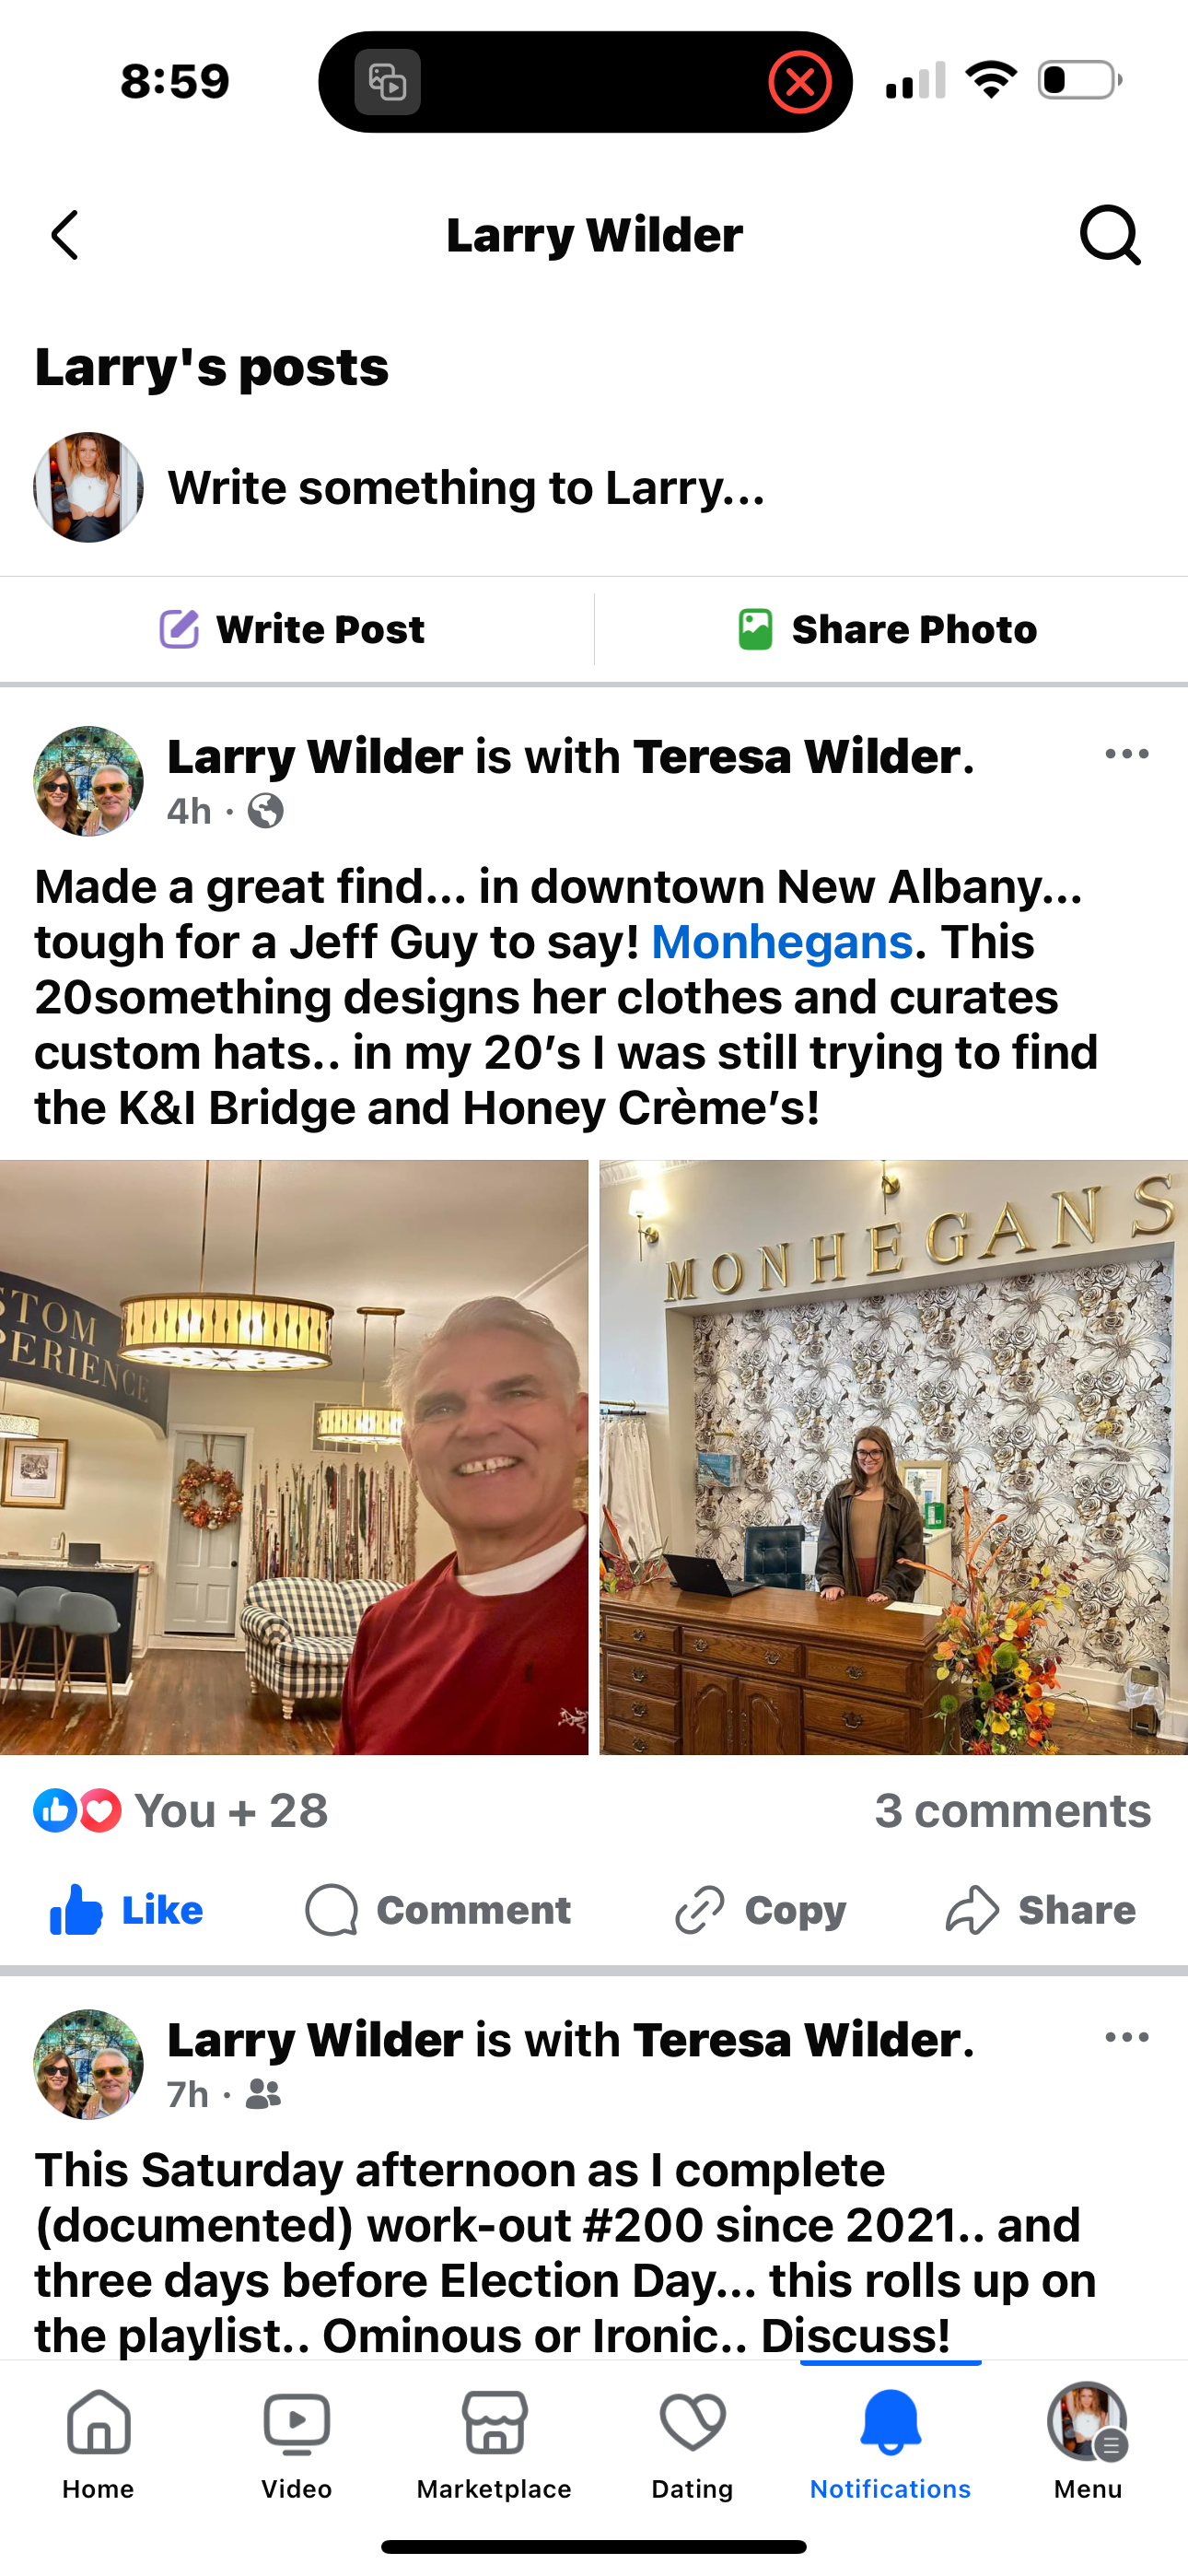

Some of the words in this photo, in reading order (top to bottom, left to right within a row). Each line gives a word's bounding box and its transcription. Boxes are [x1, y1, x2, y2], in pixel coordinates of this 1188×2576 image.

[121, 63, 229, 100] 8:59
[448, 217, 576, 262] Larry
[585, 212, 744, 253] Wilder
[36, 347, 227, 396] Larry's
[239, 349, 390, 395] posts
[167, 466, 287, 506] Write
[298, 466, 535, 514] something
[548, 472, 594, 506] to
[607, 470, 763, 514] Larry...
[215, 611, 325, 645] Write
[335, 615, 425, 645] Post
[792, 613, 910, 645] Share
[920, 613, 1038, 645] Photo
[169, 739, 297, 783] Larry
[306, 733, 464, 775] Wilder
[476, 735, 512, 775] is
[524, 735, 620, 774] with
[633, 739, 791, 775] Teresa
[803, 733, 973, 775] Wilder.
[167, 796, 211, 825] 4h
[36, 867, 157, 905] Made
[169, 876, 193, 905] a
[206, 871, 325, 913] great
[336, 865, 465, 905] find...
[480, 865, 518, 904] in
[530, 867, 764, 905] downtown
[778, 869, 877, 905] New
[888, 867, 1081, 913] Albany...
[33, 922, 164, 968] tough
[175, 922, 240, 960] for
[251, 931, 276, 960] a
[289, 922, 379, 960] Jeff
[390, 923, 479, 968] Guy
[489, 926, 536, 960] to
[547, 924, 638, 968] say!
[653, 922, 926, 968] Monhegans.
[940, 920, 1035, 960] This
[35, 976, 331, 1024] 20something
[344, 976, 520, 1024] designs
[533, 978, 607, 1015] her
[617, 978, 783, 1015] clothes
[794, 978, 877, 1015] and
[890, 981, 1059, 1015] curates
[34, 1036, 200, 1071] custom
[215, 1033, 339, 1071] hats..
[354, 1031, 391, 1070] in
[405, 1042, 472, 1079] my
[484, 1034, 581, 1071] 20’s
[594, 1035, 603, 1070] I
[617, 1042, 706, 1071] was
[717, 1031, 797, 1071] still
[809, 1031, 942, 1079] trying
[954, 1036, 1001, 1071] to
[1011, 1031, 1098, 1071] find
[33, 1088, 107, 1126] the
[120, 1089, 194, 1126] K&I
[210, 1086, 356, 1134] Bridge
[367, 1088, 449, 1126] and
[464, 1090, 607, 1134] Honey
[619, 1086, 819, 1126] Crème’s!
[664, 1173, 1176, 1302] MONHEGANS
[0, 1287, 97, 1347] TOM
[0, 1329, 148, 1403] ERIENCE
[134, 1793, 215, 1829] You
[228, 1800, 256, 1827] +
[270, 1792, 328, 1829] 28
[875, 1792, 903, 1829] 3
[914, 1795, 1152, 1829] comments
[122, 1891, 204, 1926] Like
[377, 1895, 572, 1926] Comment
[745, 1895, 847, 1932] Copy
[1019, 1893, 1136, 1926] Share
[169, 2022, 297, 2067] Larry
[306, 2017, 464, 2058] Wilder
[476, 2019, 512, 2058] is
[524, 2019, 620, 2057] with
[633, 2022, 791, 2058] Teresa
[803, 2017, 973, 2058] Wilder.
[167, 2079, 208, 2108] 7h
[34, 2149, 129, 2188] This
[142, 2150, 344, 2196] Saturday
[355, 2150, 576, 2188] afternoon
[588, 2160, 639, 2188] as
[652, 2152, 661, 2187] I
[675, 2150, 886, 2195] complete
[37, 2206, 353, 2251] (documented)
[367, 2206, 572, 2243] work-out
[582, 2207, 704, 2243] #200
[716, 2204, 834, 2243] since
[846, 2207, 984, 2243] 2021..
[997, 2206, 1080, 2243] and
[33, 2261, 153, 2299] three
[164, 2261, 270, 2307] days
[284, 2261, 428, 2299] before
[441, 2259, 619, 2299] Election
[634, 2263, 755, 2307] Day...
[768, 2259, 853, 2299] this
[866, 2261, 961, 2299] rolls
[973, 2270, 1030, 2306] up
[1042, 2270, 1096, 2299] on
[33, 2316, 107, 2354] the
[119, 2314, 309, 2360] playlist..
[323, 2314, 522, 2354] Ominous
[534, 2325, 581, 2354] or
[594, 2314, 746, 2354] Ironic..
[763, 2314, 949, 2354] Discuss!
[63, 2479, 134, 2499] Home
[261, 2477, 332, 2499] Video
[417, 2478, 572, 2503] Marketplace
[652, 2477, 733, 2503] Dating
[810, 2477, 972, 2499] Notifications
[1054, 2479, 1122, 2499] Menu
